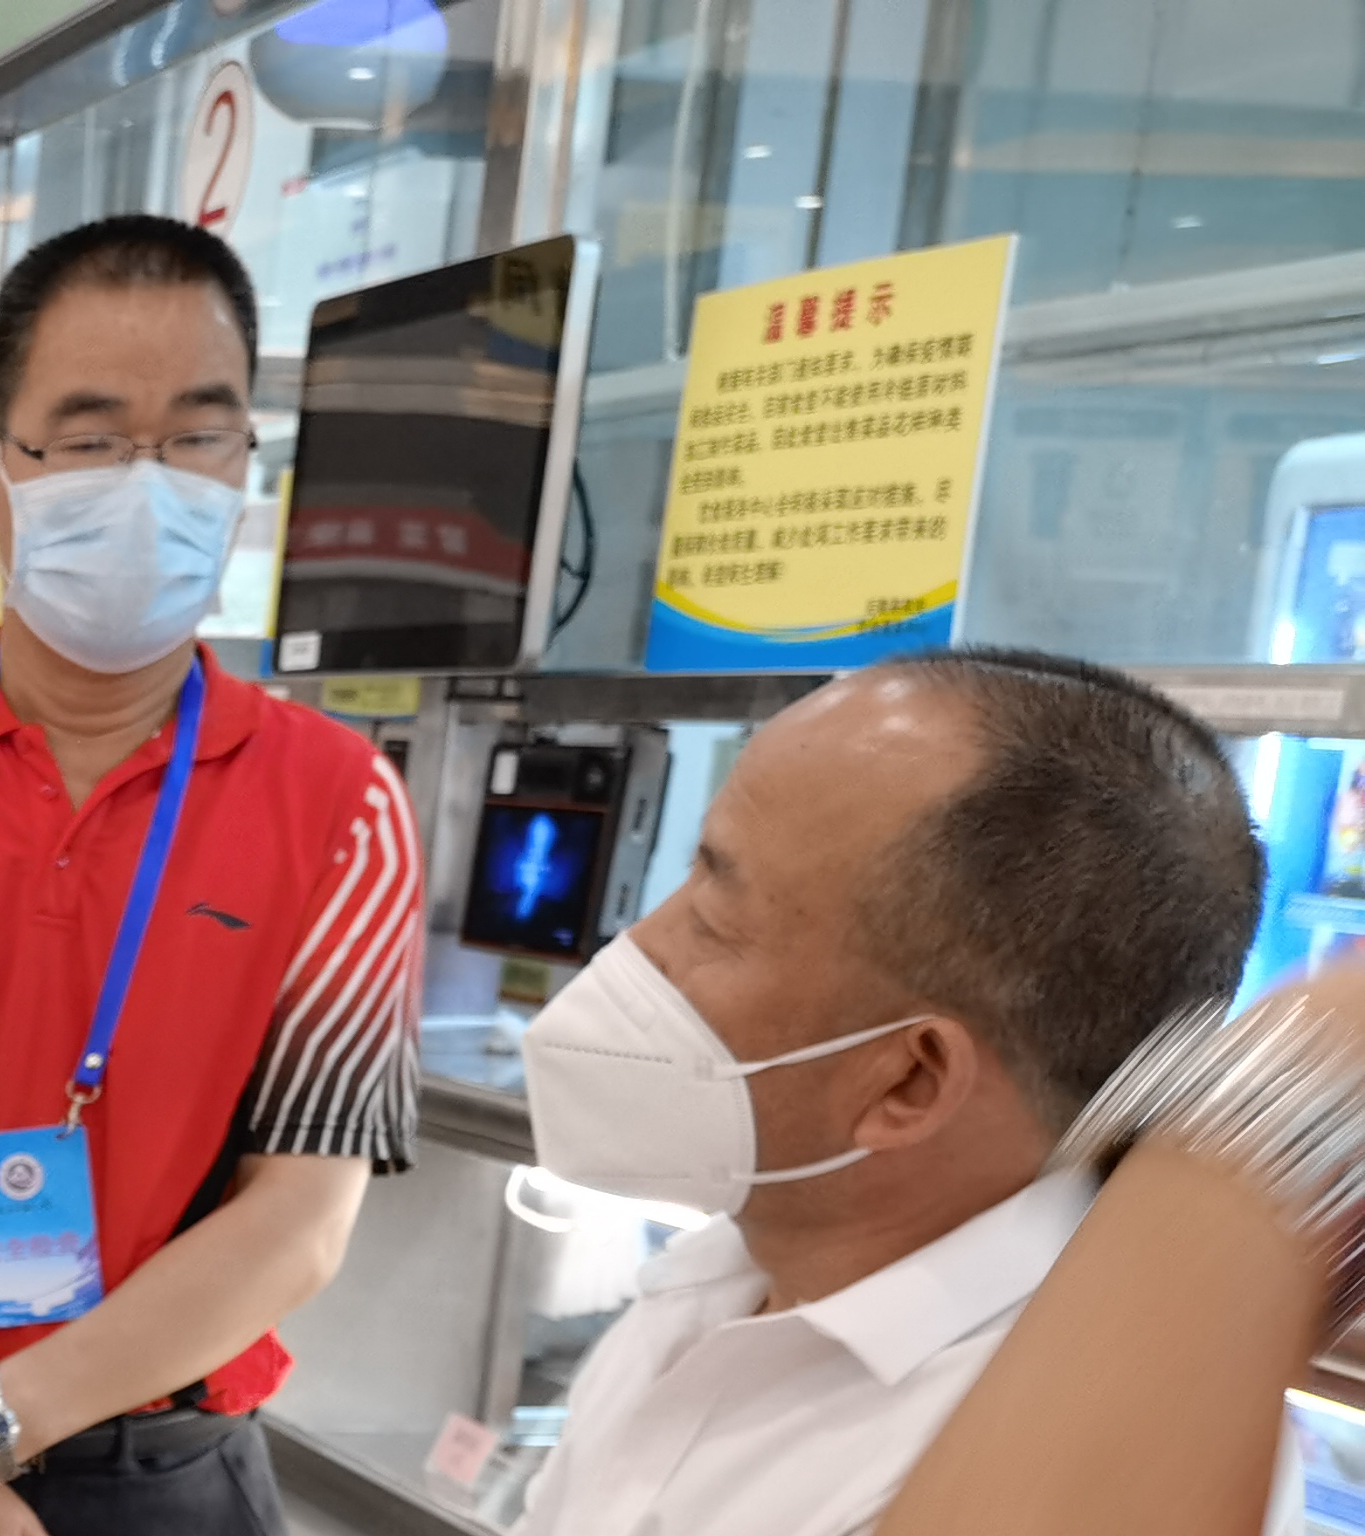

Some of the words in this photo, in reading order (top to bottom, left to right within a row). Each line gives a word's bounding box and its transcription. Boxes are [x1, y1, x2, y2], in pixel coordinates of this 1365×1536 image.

[198, 90, 237, 227] 2
[763, 282, 894, 344] 温馨提示
